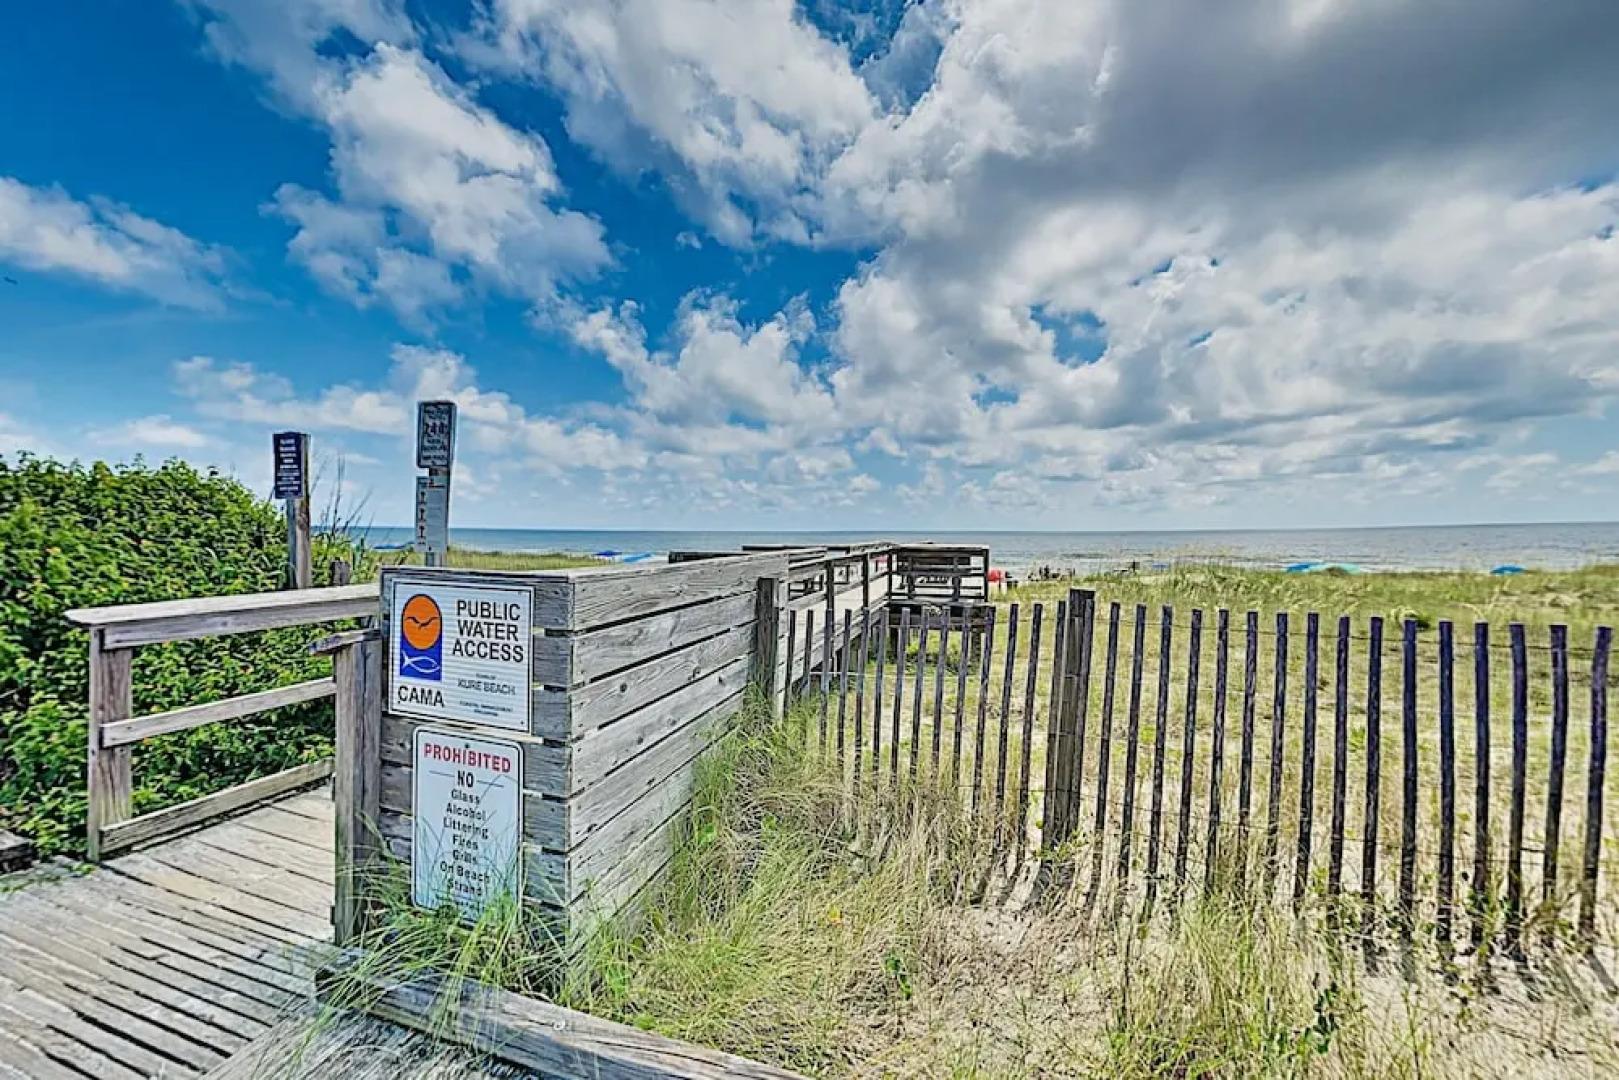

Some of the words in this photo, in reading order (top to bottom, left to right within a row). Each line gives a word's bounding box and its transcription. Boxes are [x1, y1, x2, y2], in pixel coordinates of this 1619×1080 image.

[457, 600, 521, 621] PUBLIC
[457, 619, 519, 642] WATER
[452, 638, 524, 663] ACCESS
[398, 685, 445, 708] CAMA
[457, 678, 482, 691] KURE
[484, 682, 516, 696] BEACH
[423, 742, 511, 774] PROHIBITED
[457, 770, 474, 788] NO
[451, 788, 480, 806] Glass
[446, 802, 486, 821] Alcohol
[443, 817, 489, 840] Littering
[452, 833, 479, 851] Fires
[440, 860, 454, 873] On
[456, 865, 490, 884] Beach
